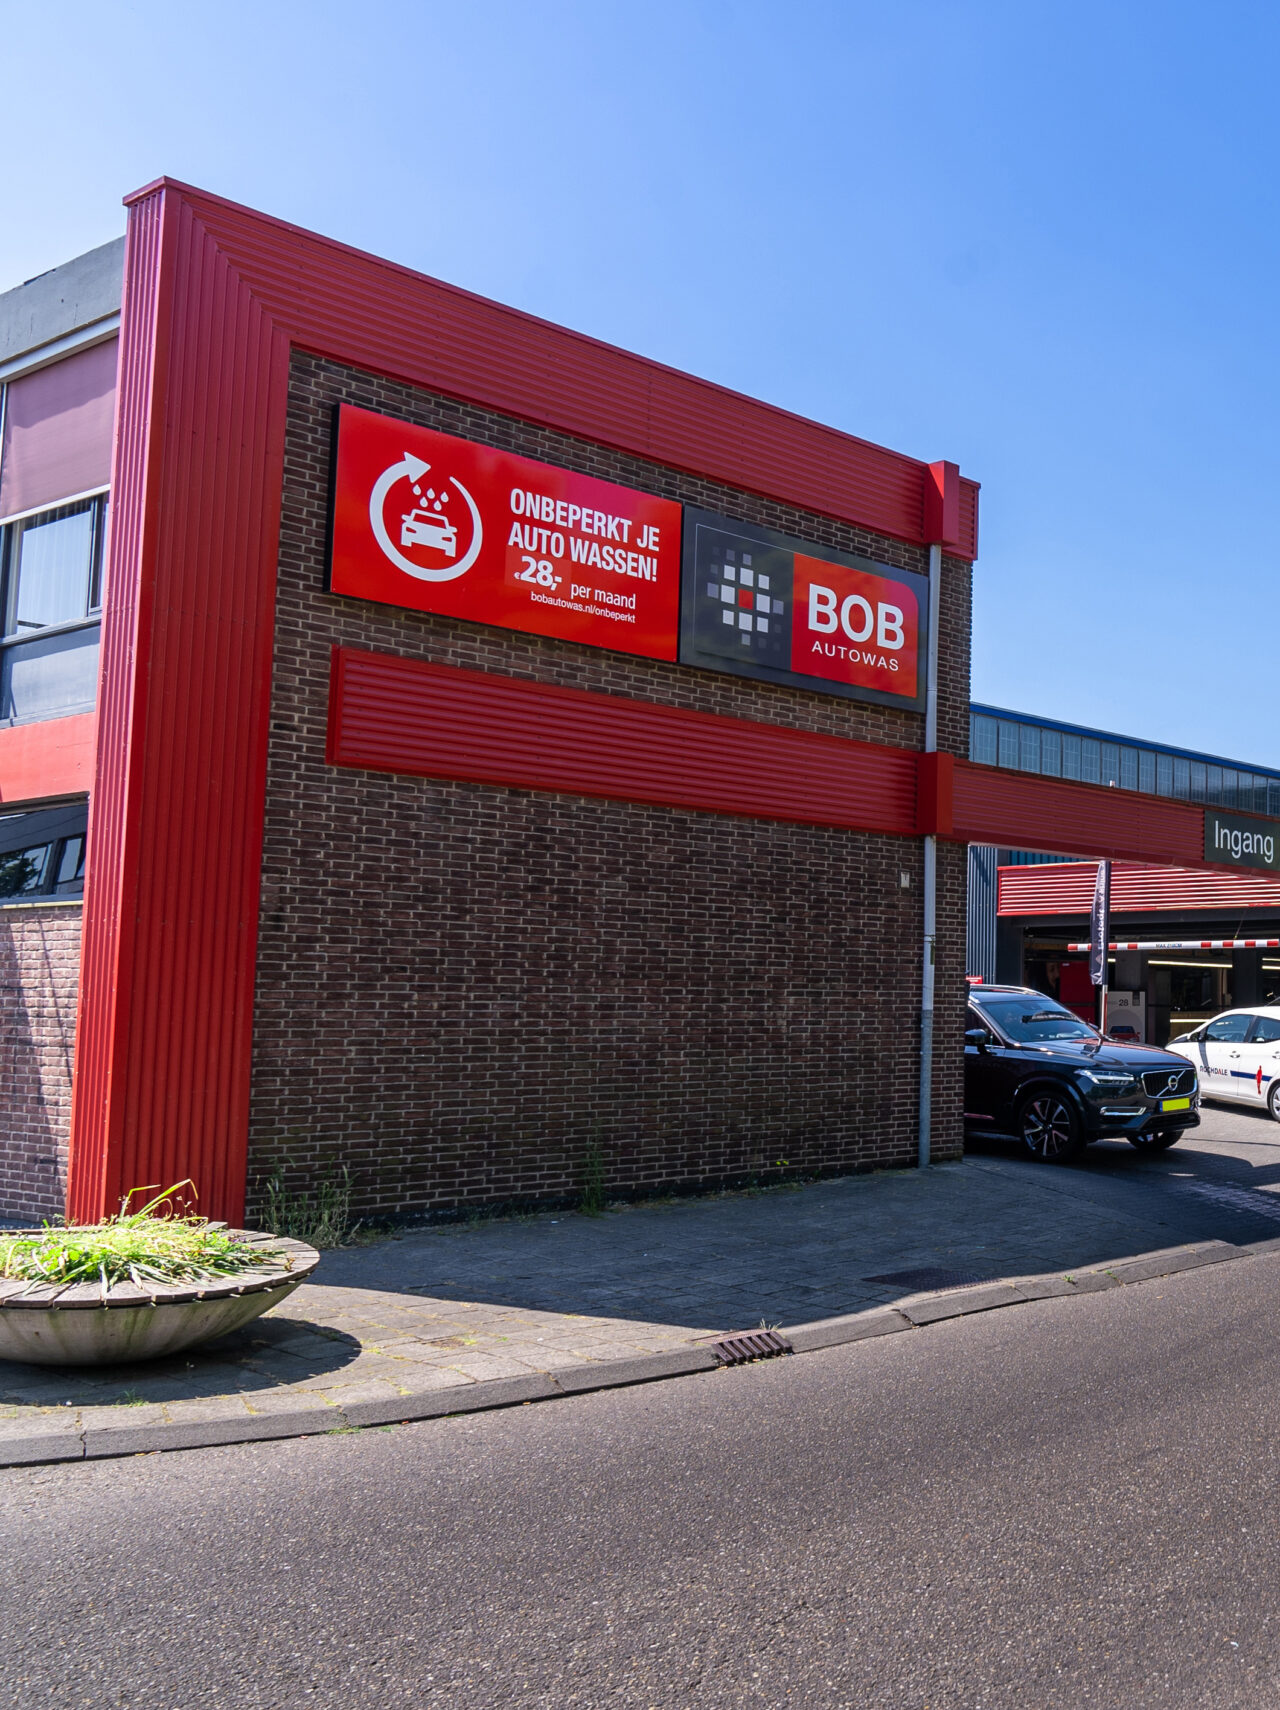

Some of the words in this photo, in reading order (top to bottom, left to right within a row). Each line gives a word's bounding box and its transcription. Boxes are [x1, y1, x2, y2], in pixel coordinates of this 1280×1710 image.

[510, 488, 632, 543] ONBEPERKT
[636, 524, 660, 552] JE
[508, 522, 565, 559] AUTO
[569, 536, 658, 582] WASSEN!
[530, 591, 636, 624] bobautowas.nl/onbeperkt
[570, 582, 592, 600] per
[594, 589, 636, 610] maand
[808, 583, 905, 650] BOB
[811, 640, 899, 672] AUTOWAS
[1215, 820, 1274, 864] Ingang
[1118, 999, 1129, 1007] 28
